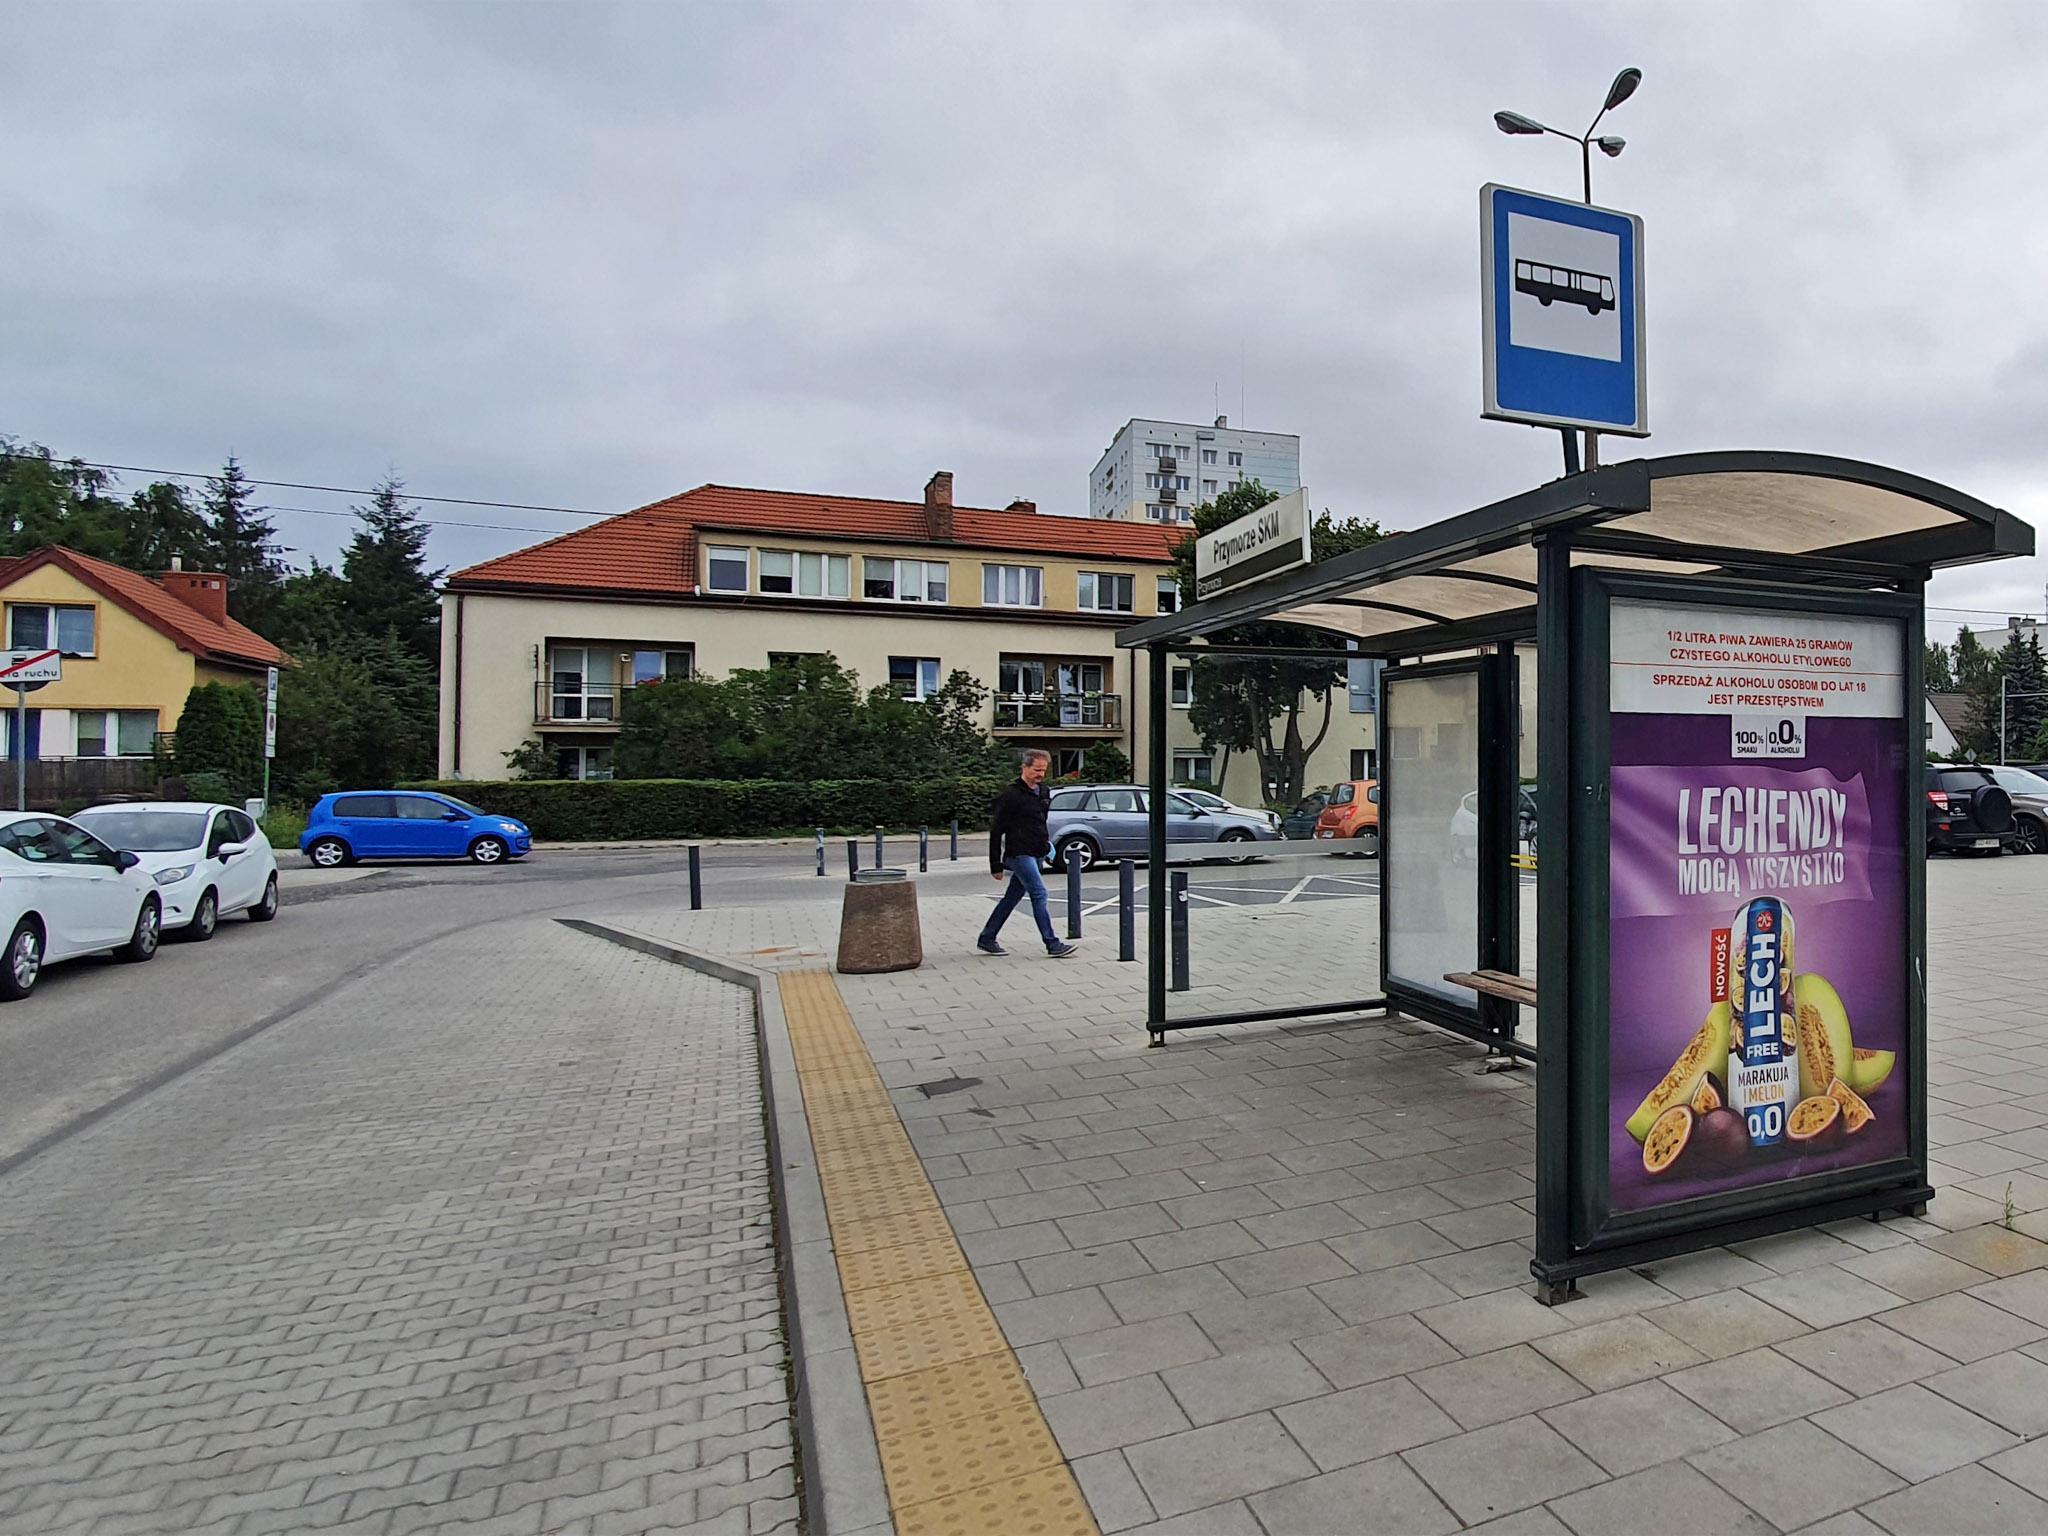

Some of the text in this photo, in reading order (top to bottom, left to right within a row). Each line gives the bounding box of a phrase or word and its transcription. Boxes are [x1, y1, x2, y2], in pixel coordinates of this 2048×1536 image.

[1214, 510, 1280, 565] Przymorze SKM
[1667, 630, 1853, 651] 1/2 LITRA PIWA ZAWIERA 25 GRAMÓW
[1670, 648, 1852, 667] CZYSTEGO ALKOHOLU ETYLOWEGO
[25, 668, 58, 678] ruchu
[1653, 674, 1866, 692] SPRZEDAŻ ALKOHOLU OSOBOM DO LAT 18
[1708, 694, 1824, 708] JEST PRZESTĘPSTWEM
[1735, 731, 1764, 744] 100%
[1737, 746, 1757, 754] SMAKU
[1771, 746, 1800, 754] ALKOHOLU
[1678, 786, 1846, 855] LECHENDY
[1678, 852, 1844, 898] MOGĄ WSZYSTKO
[1715, 933, 1727, 997] NOWOŚĆ
[1750, 933, 1776, 1038] LECH
[1746, 1042, 1779, 1059] FREE
[1738, 1066, 1789, 1087] MARAKUJA
[1749, 1084, 1785, 1103] MELON
[1748, 1105, 1782, 1140] 0,0
